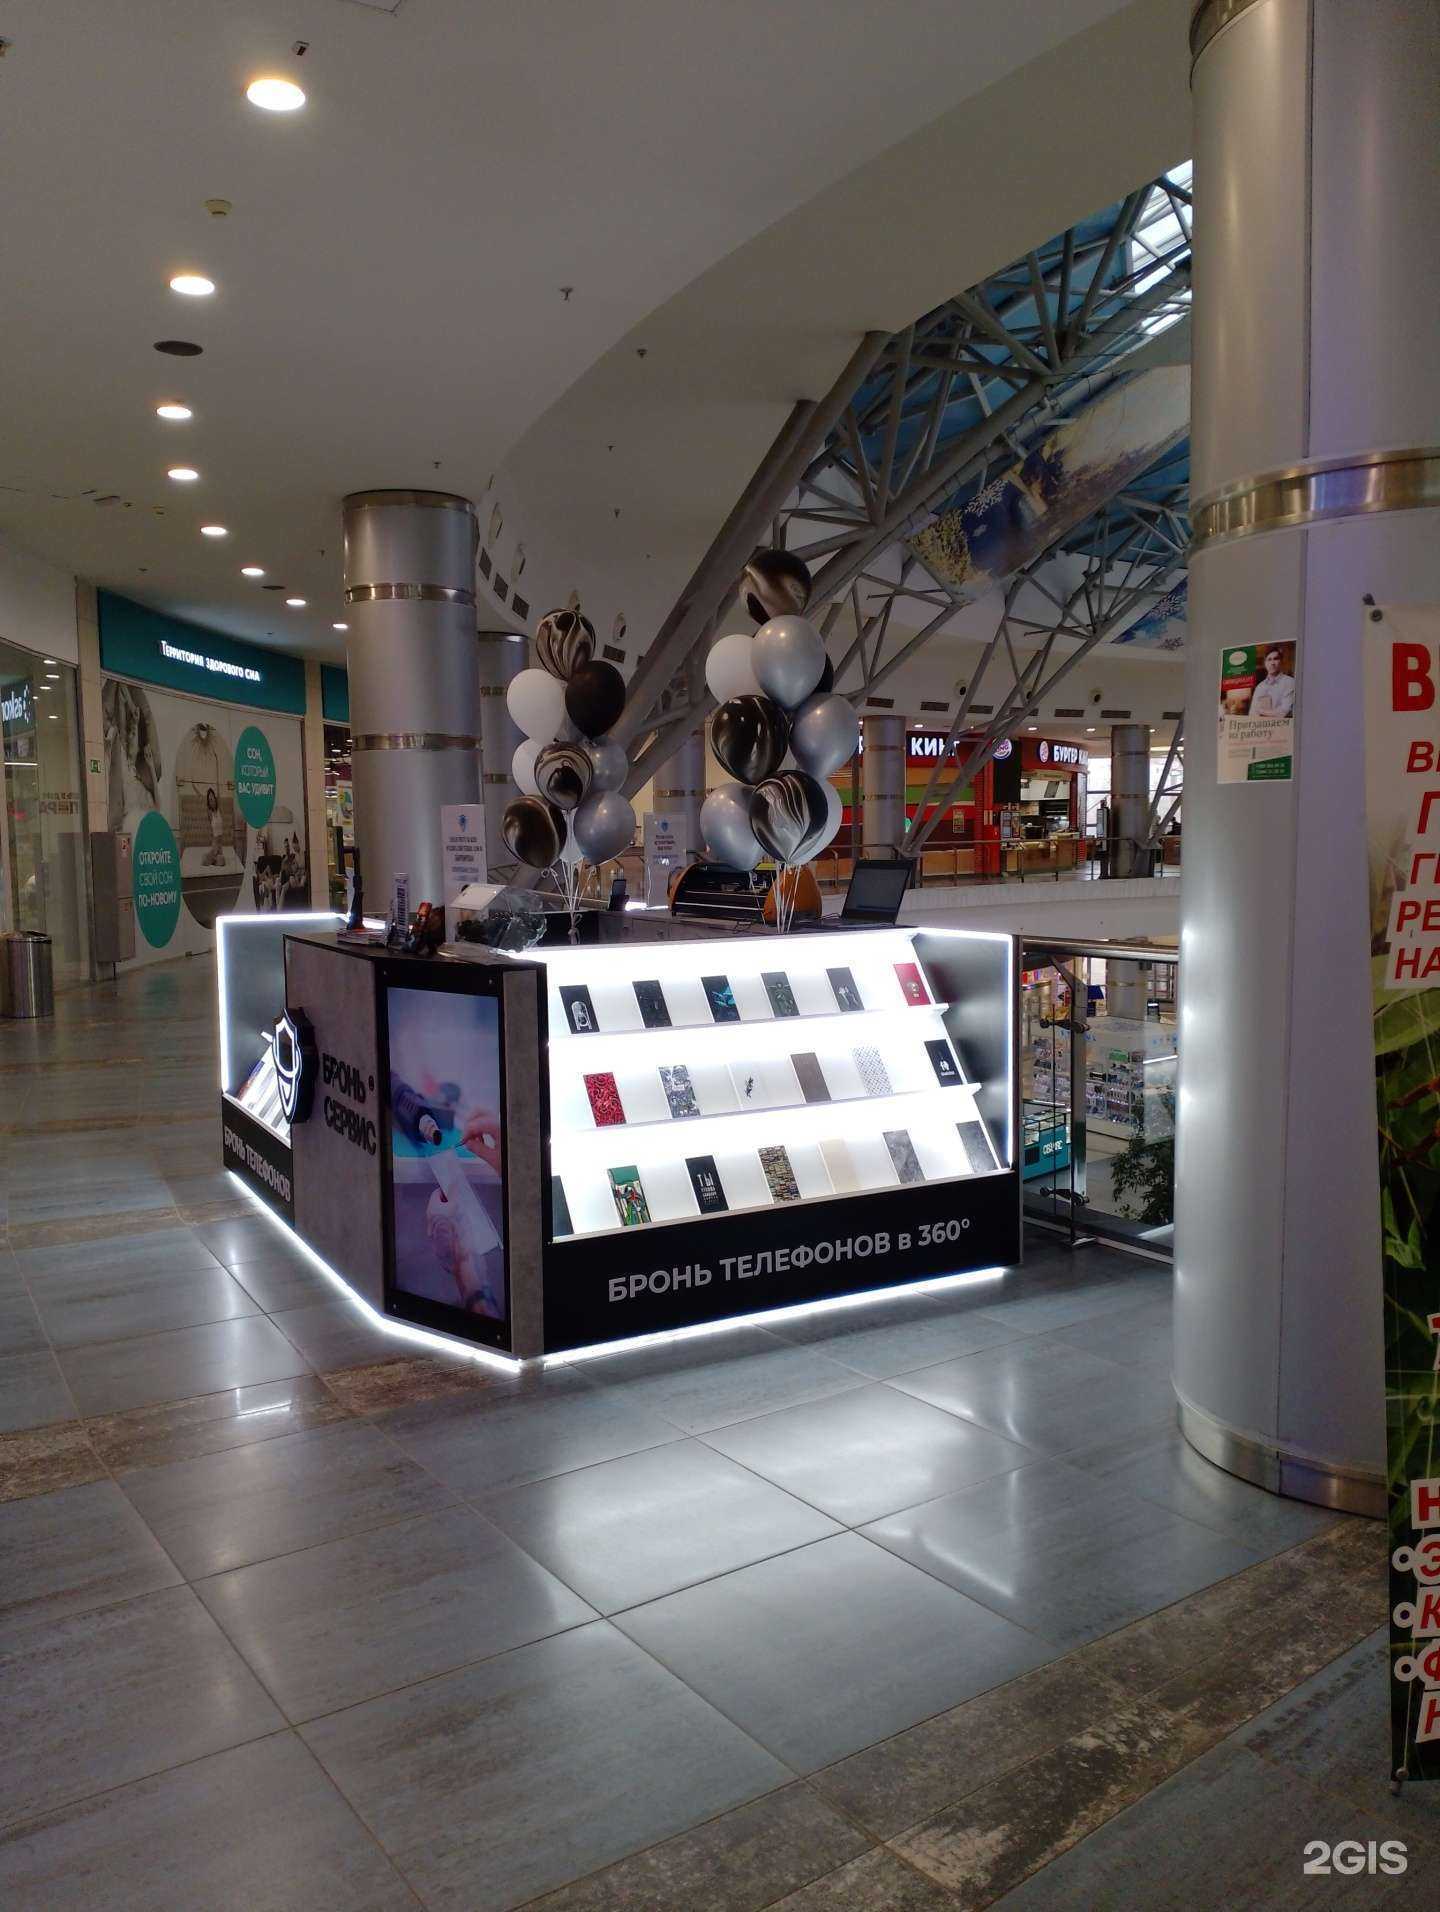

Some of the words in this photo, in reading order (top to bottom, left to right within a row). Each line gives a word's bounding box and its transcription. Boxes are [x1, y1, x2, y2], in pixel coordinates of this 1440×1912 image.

[205, 657, 244, 679] ЗДОРОВОГО
[244, 668, 260, 681] СНА
[1392, 643, 1440, 711] В
[1053, 744, 1078, 763] БУРГЕР
[1407, 741, 1440, 773] В
[238, 782, 251, 795] ВАС
[252, 782, 273, 796] УДИВИТ
[139, 848, 172, 865] ОТКРОЙТЕ
[1410, 853, 1440, 885] Г
[138, 891, 177, 907] ПО-НОВОМУ
[322, 1052, 366, 1104] БРОНЬ
[324, 1095, 376, 1156] СЕРВИС
[224, 1126, 245, 1161] БРОНЬ
[245, 1145, 290, 1202] ТЕЛЕФОНОВ
[608, 1263, 712, 1302] БРОНЬ
[719, 1232, 891, 1281] ТЕЛЕФОНОВ
[918, 1218, 970, 1247] 360°
